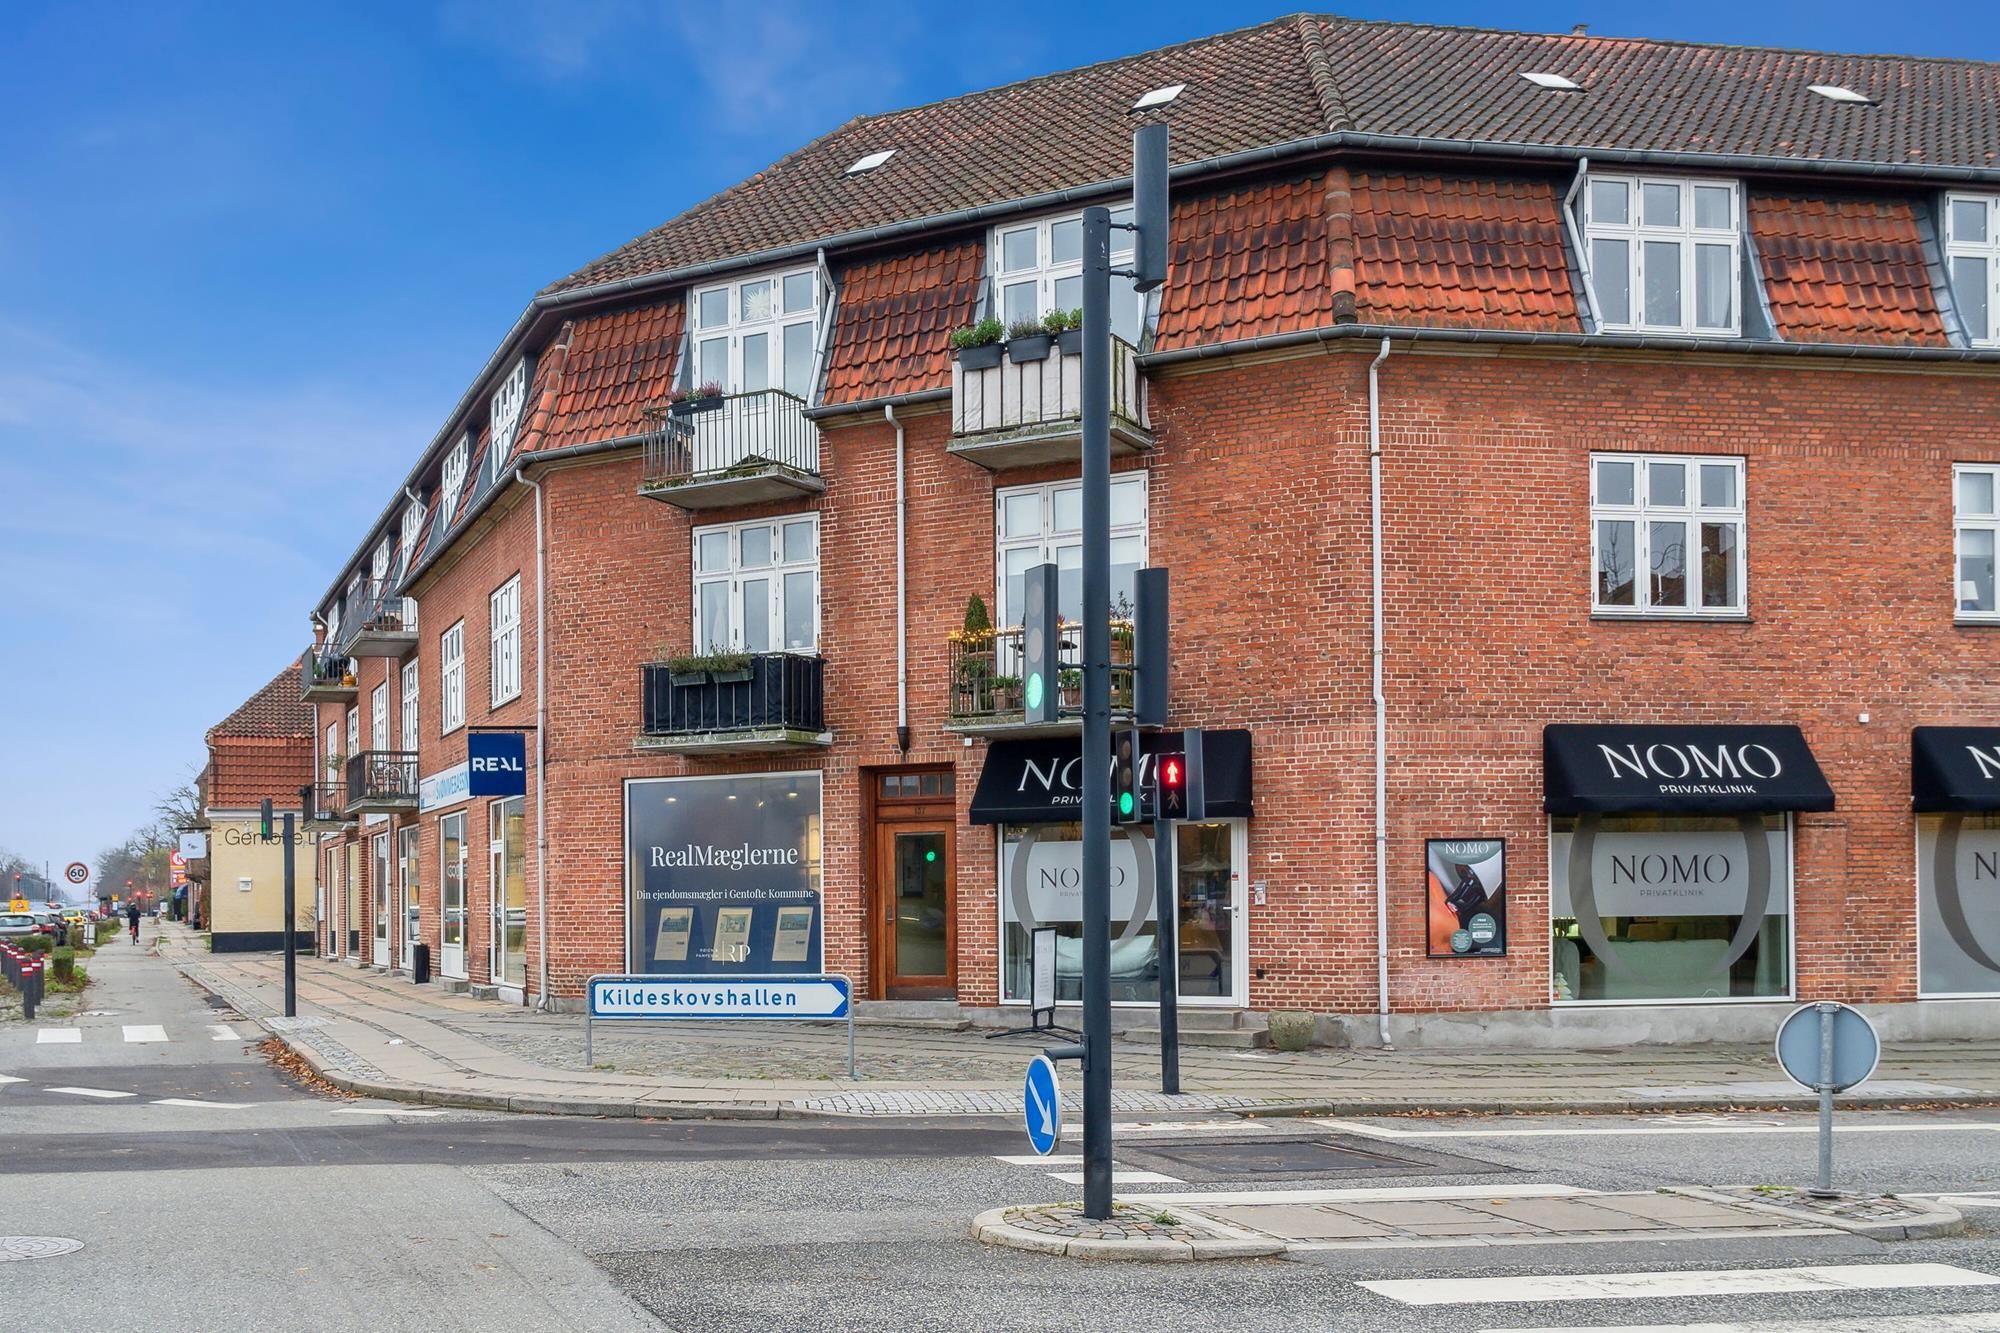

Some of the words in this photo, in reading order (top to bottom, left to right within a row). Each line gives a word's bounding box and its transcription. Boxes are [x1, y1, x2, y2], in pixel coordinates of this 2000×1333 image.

[472, 756, 523, 772] REAL
[1597, 743, 1782, 779] NOMO
[1658, 784, 1757, 794] PRIVATKLINIK
[1445, 843, 1489, 854] NOMO
[651, 843, 799, 871] RealMæglerne
[70, 868, 85, 878] 60
[1611, 854, 1730, 884] NOMO
[1040, 866, 1126, 889] NOO
[636, 889, 651, 900] Din
[652, 889, 723, 901] ejendomsmægler
[729, 889, 767, 899] Gentofte
[768, 889, 814, 899] Kommune
[1640, 889, 1704, 897] PRIVATKLINIK
[602, 988, 797, 1006] Kildeskovshallen
